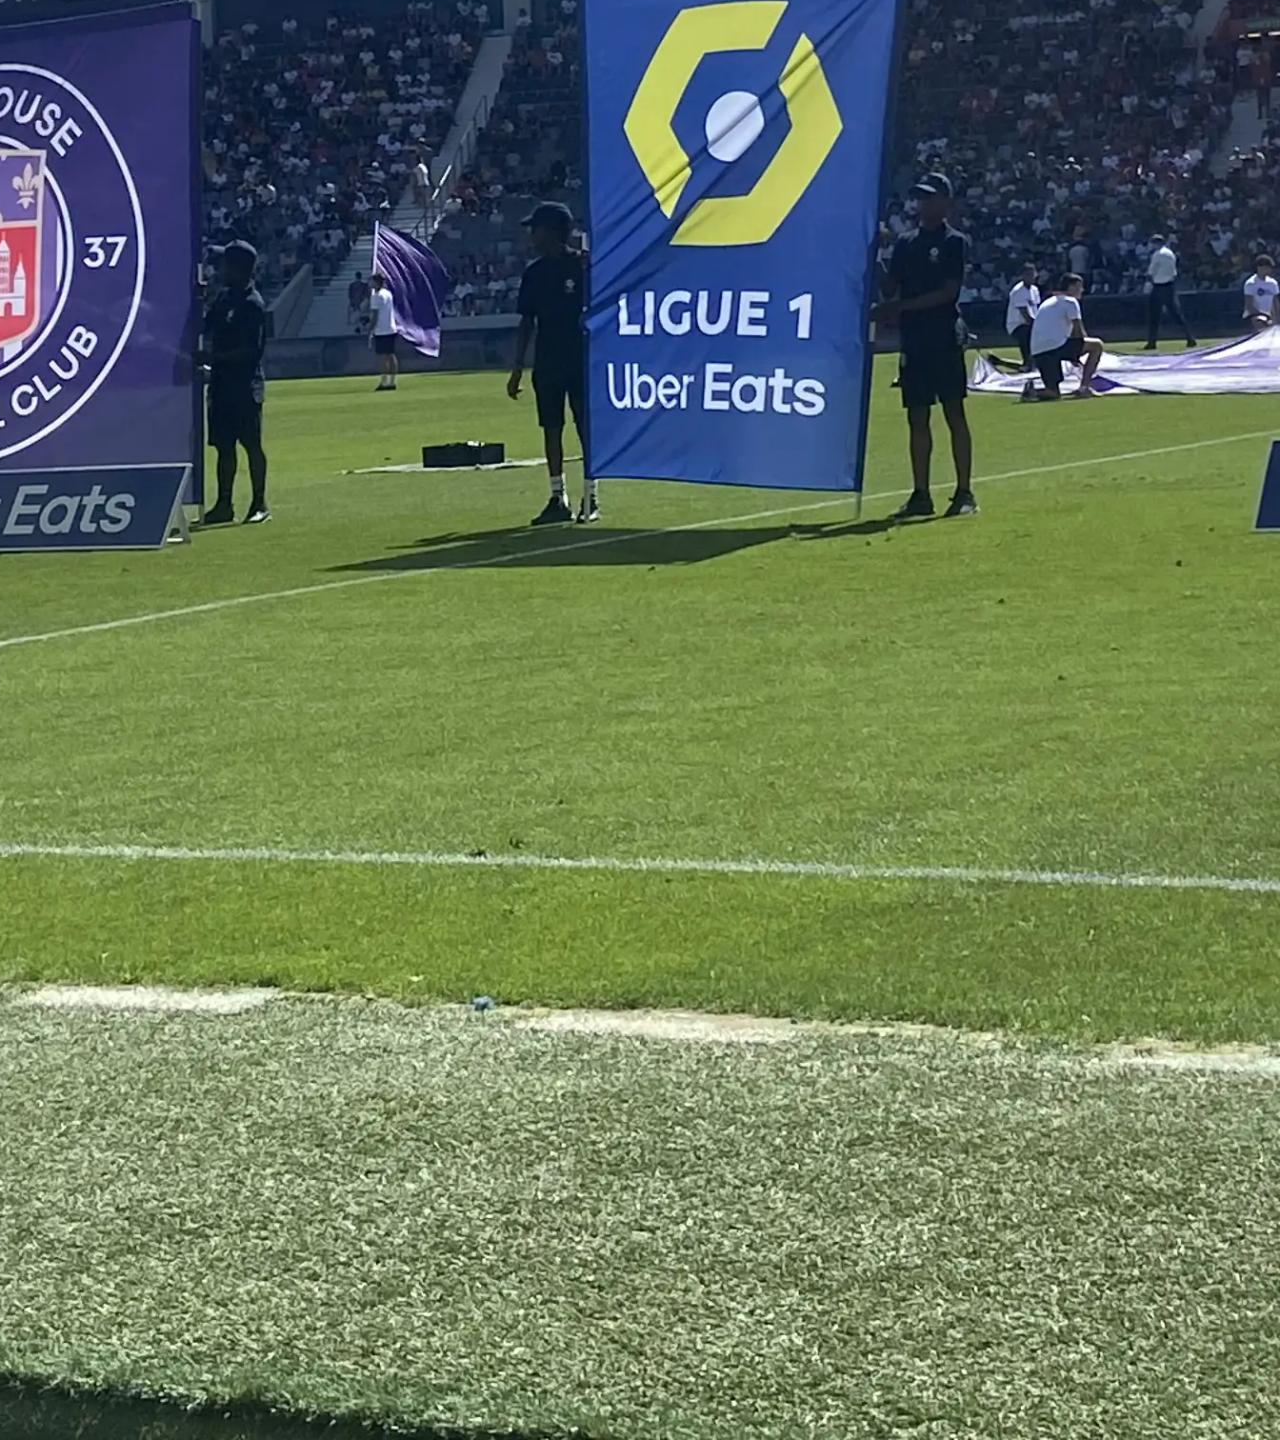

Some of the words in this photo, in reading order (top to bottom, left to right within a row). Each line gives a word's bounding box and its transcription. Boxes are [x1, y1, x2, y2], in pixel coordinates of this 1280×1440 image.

[82, 236, 128, 268] 37
[618, 289, 770, 338] LIGUE
[788, 292, 813, 340] 1
[11, 324, 99, 417] CLUB
[607, 363, 695, 410] Uber
[702, 363, 827, 416] Eats
[1, 483, 136, 537] Eats
